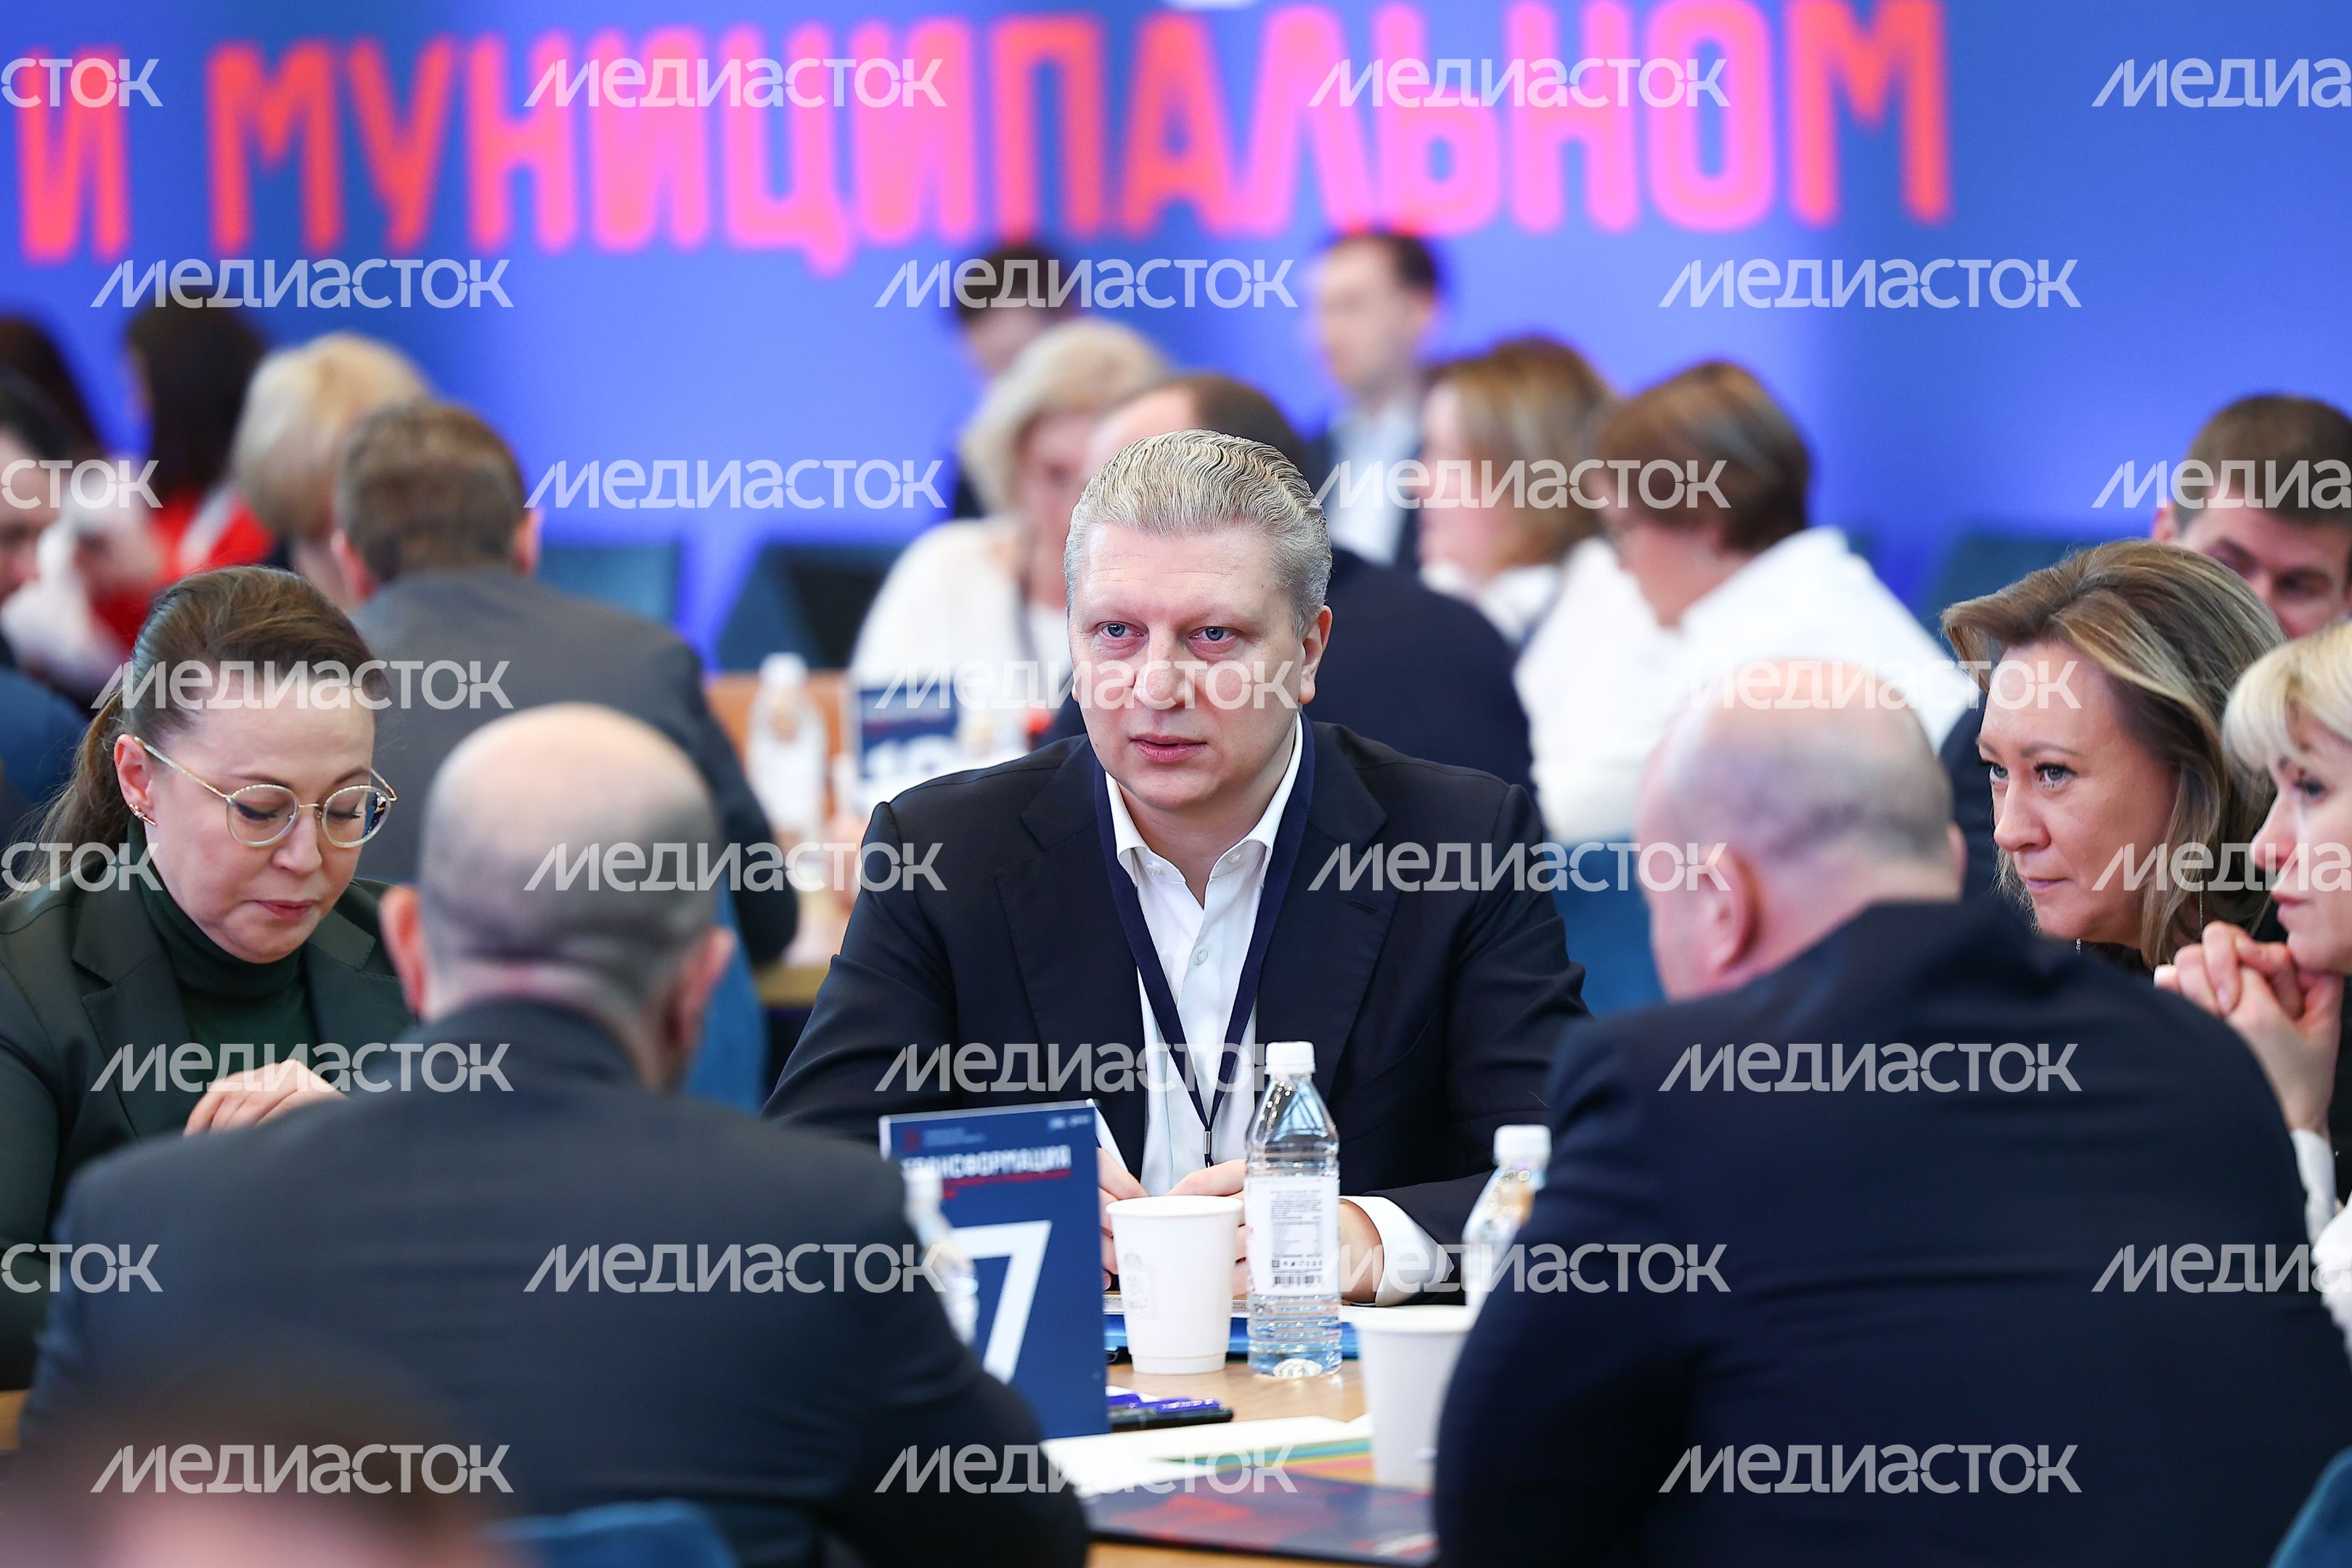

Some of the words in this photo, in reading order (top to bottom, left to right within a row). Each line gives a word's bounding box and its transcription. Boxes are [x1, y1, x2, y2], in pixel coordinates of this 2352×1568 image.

[17, 42, 132, 267] И
[207, 0, 1951, 274] МУНИЦИПАЛЬНОМ
[948, 1219, 1053, 1385] 7
